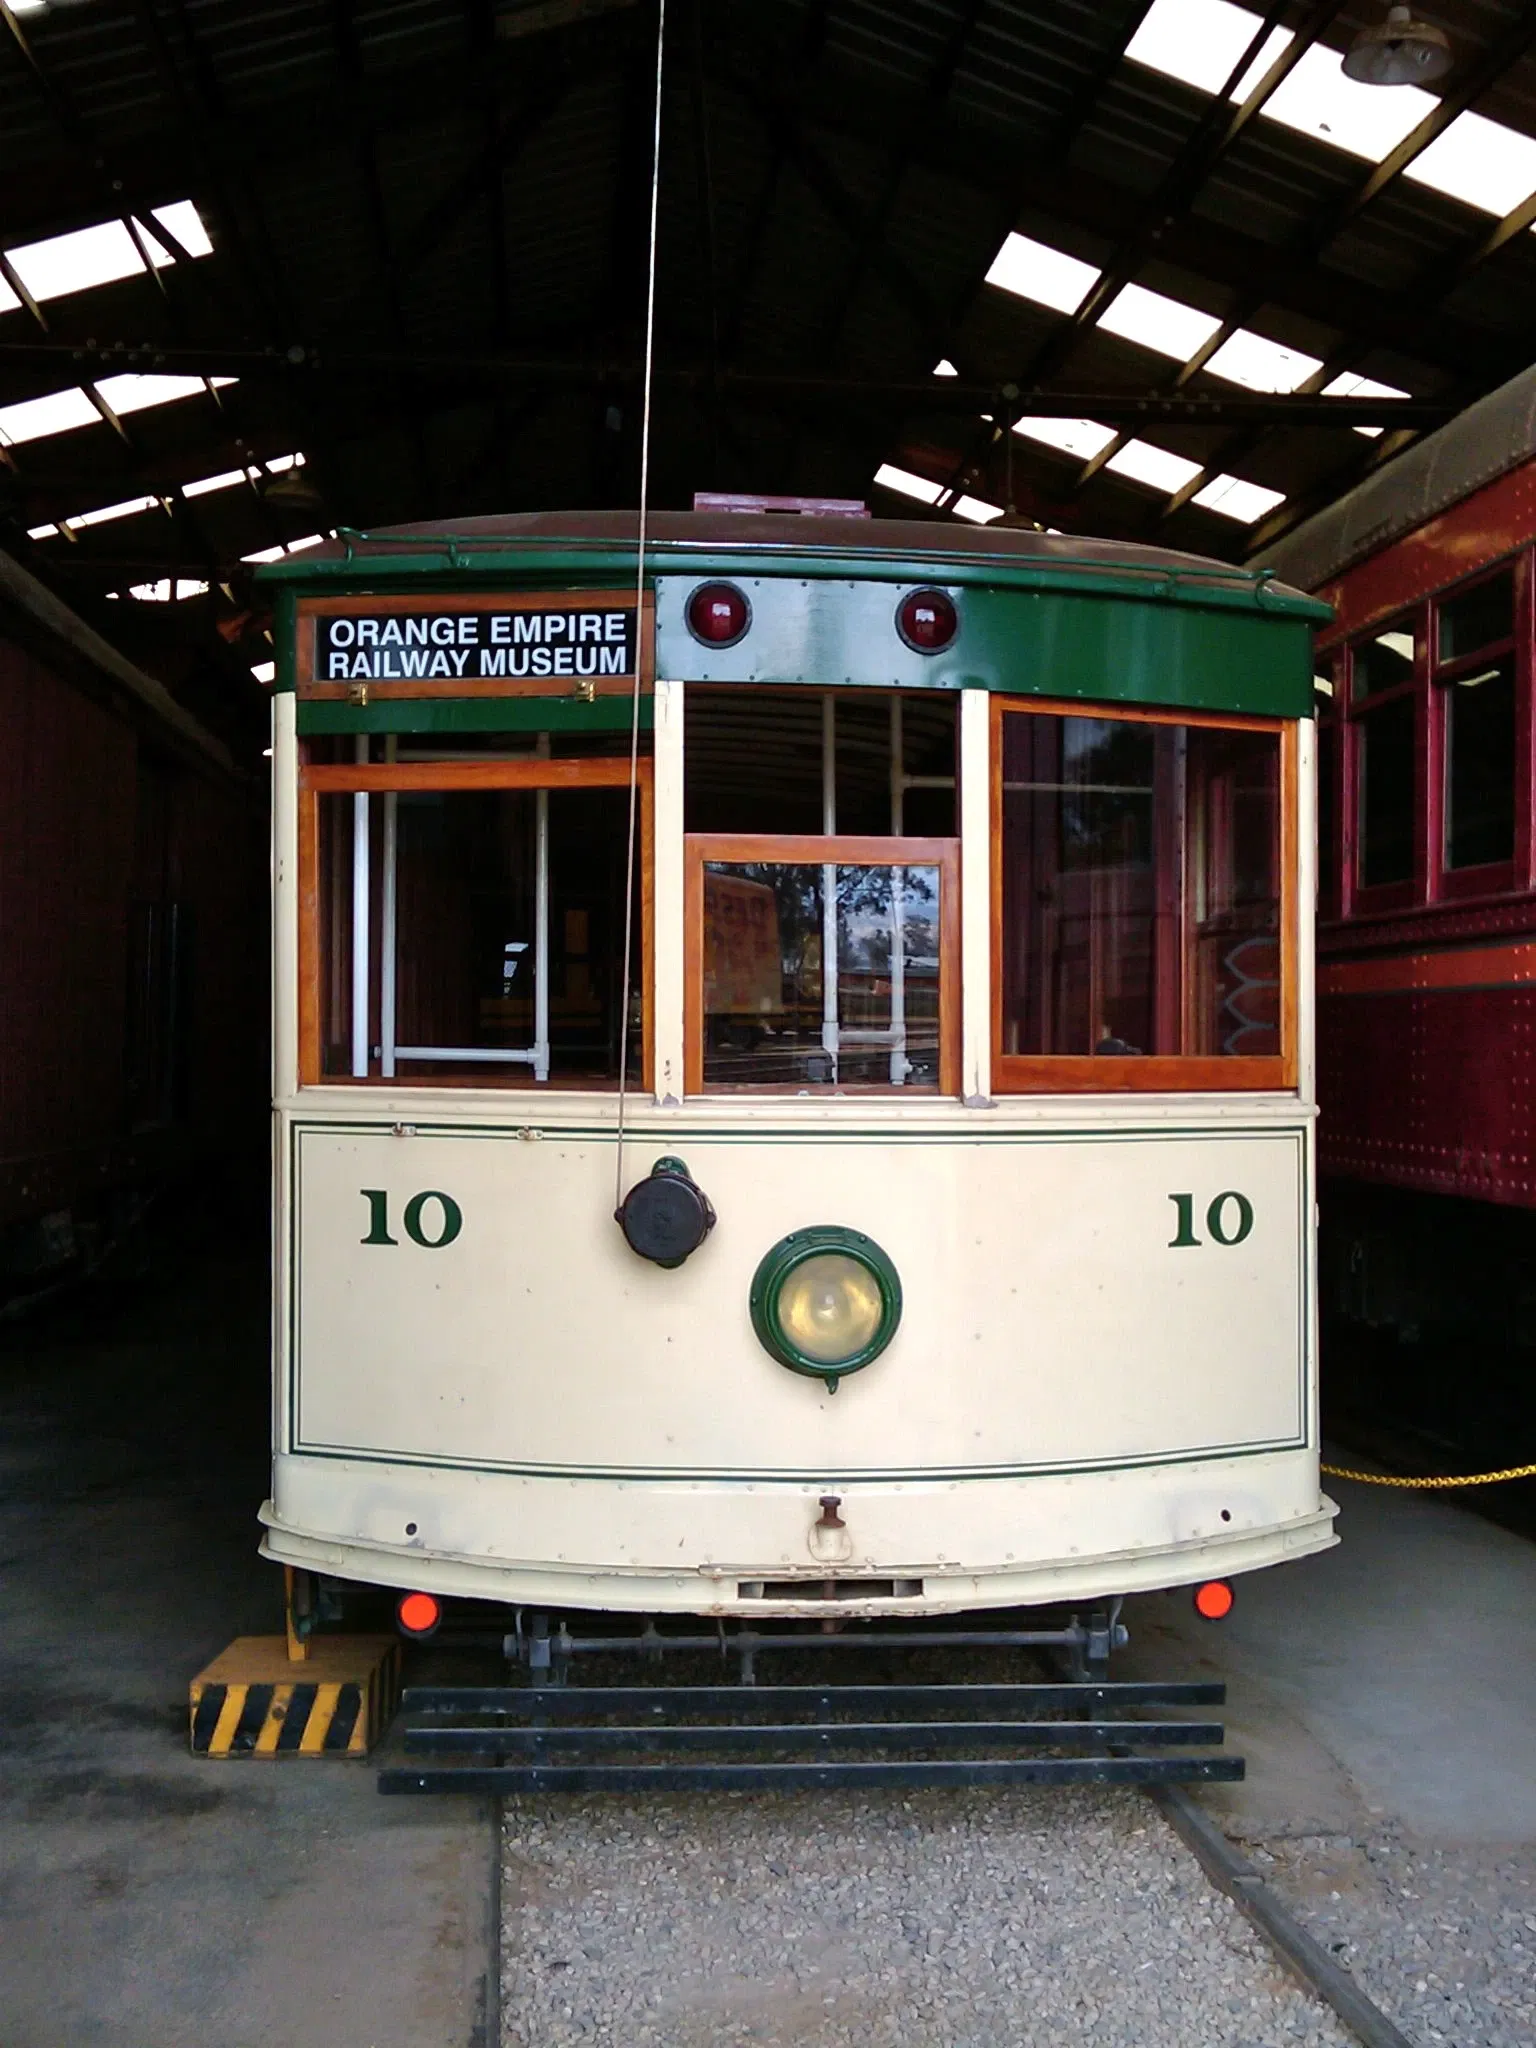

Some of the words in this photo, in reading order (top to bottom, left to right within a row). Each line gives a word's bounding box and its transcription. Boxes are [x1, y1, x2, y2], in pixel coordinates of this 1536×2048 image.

[329, 616, 479, 647] ORANGE
[490, 613, 627, 644] EMPIRE
[329, 649, 471, 679] RAILWAY
[480, 646, 627, 676] MUSEUM
[359, 1189, 463, 1249] 10
[1167, 1190, 1254, 1248] 10
